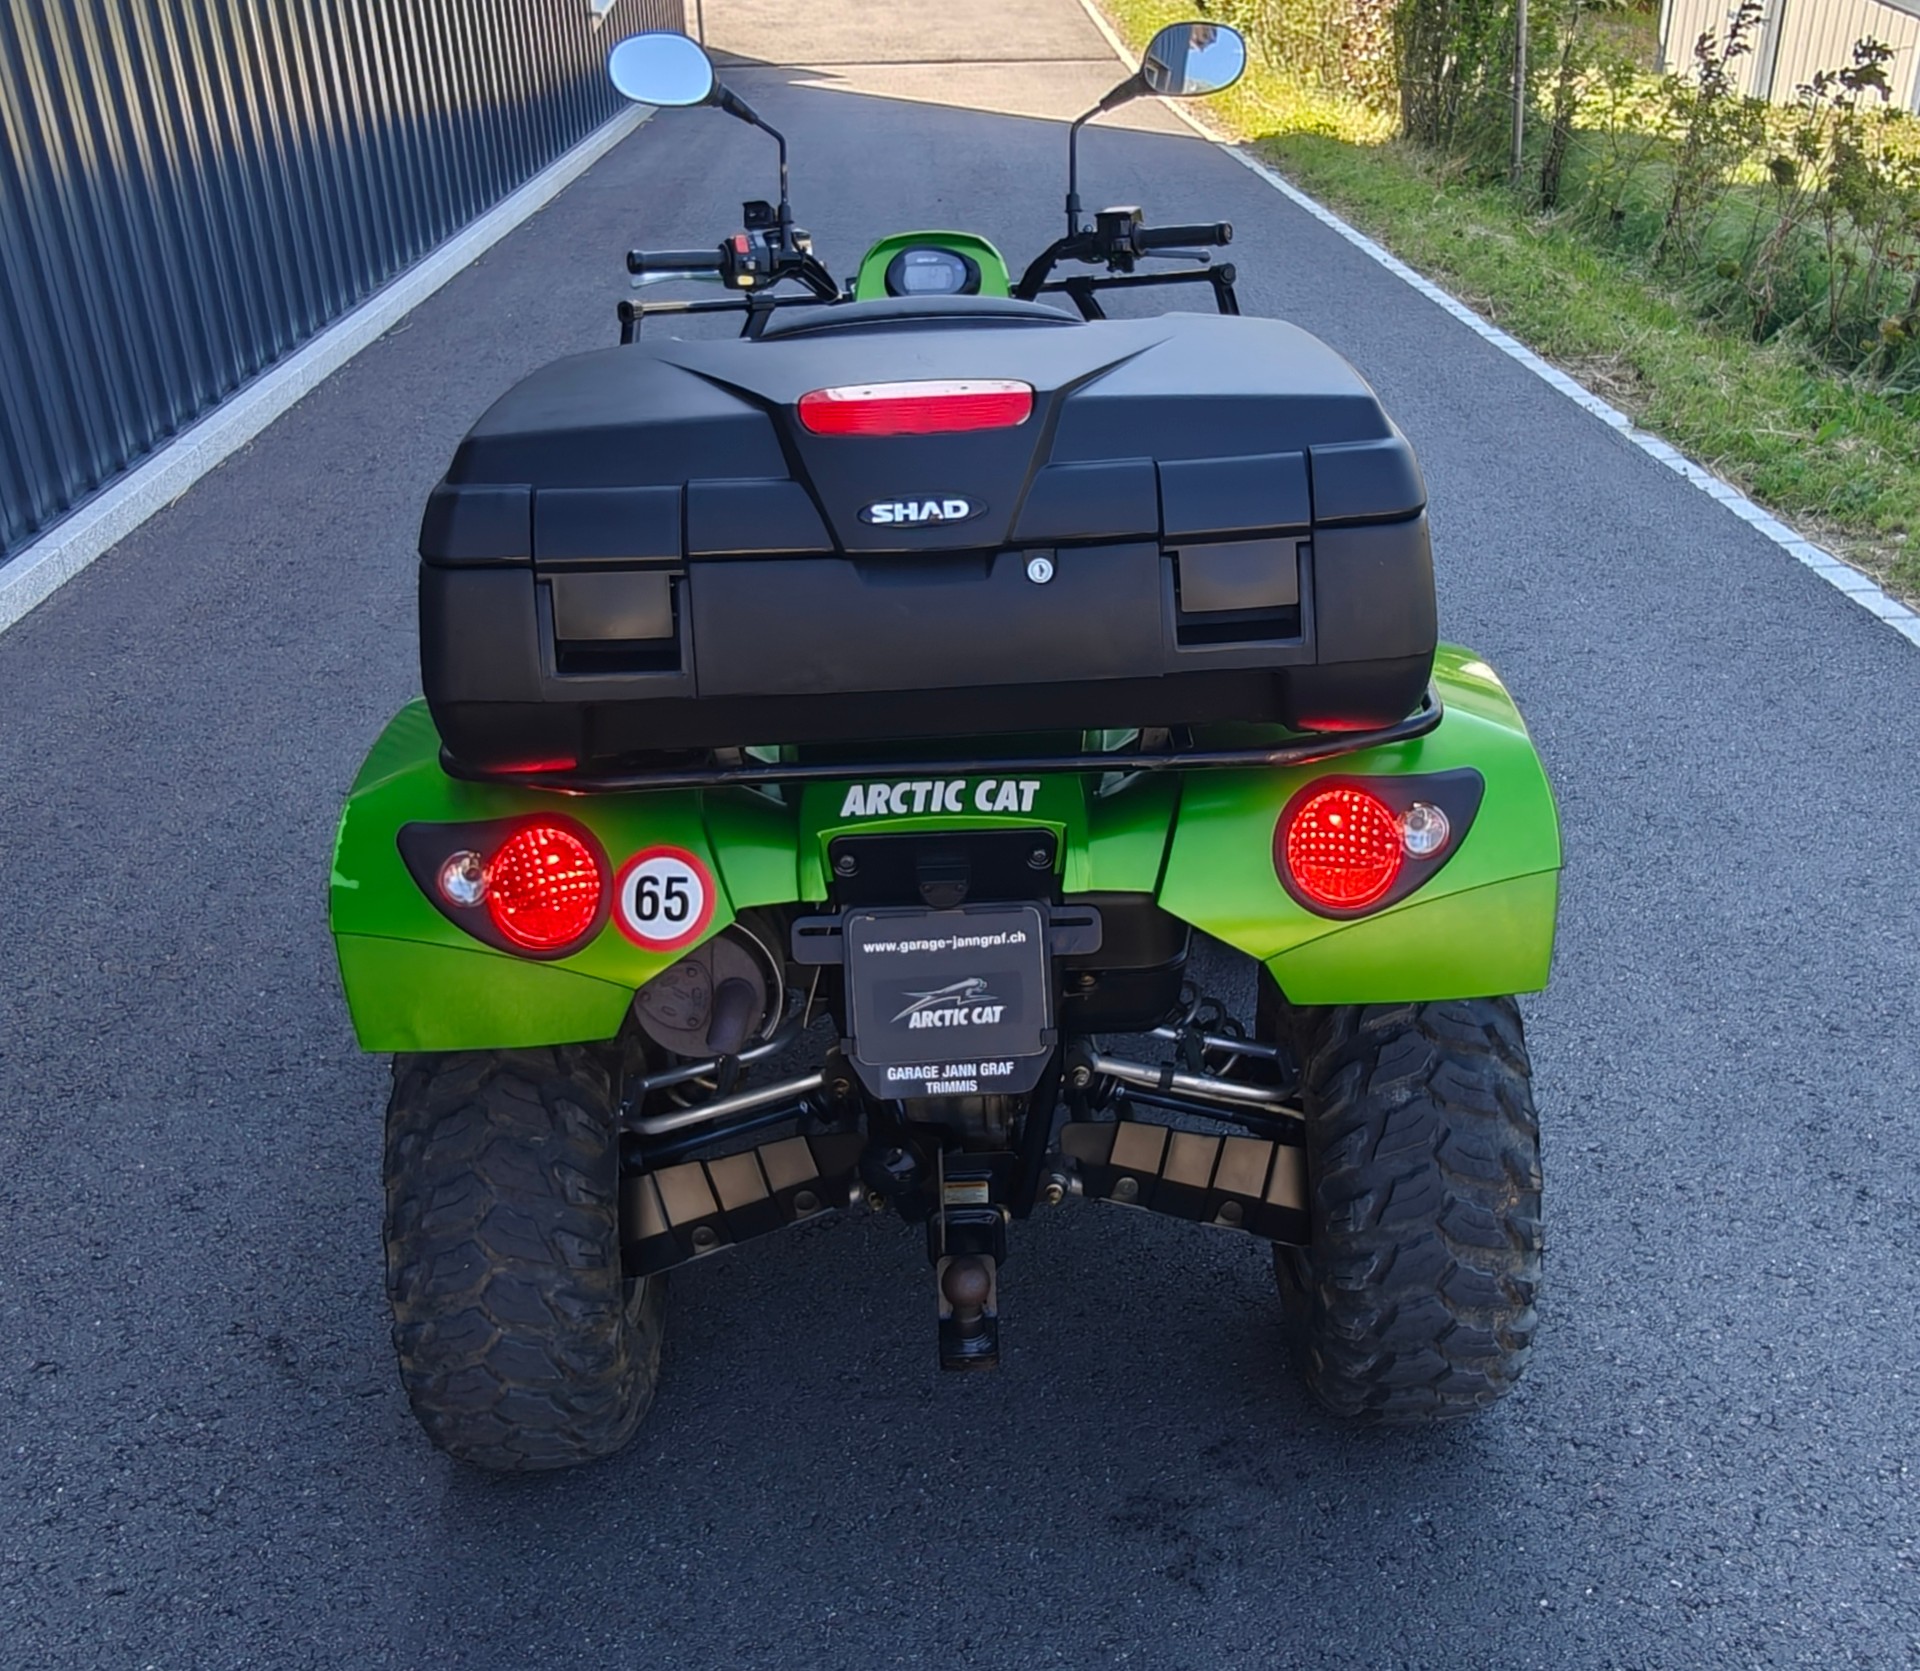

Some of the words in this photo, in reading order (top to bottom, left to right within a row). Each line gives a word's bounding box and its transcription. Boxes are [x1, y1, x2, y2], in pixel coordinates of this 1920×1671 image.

[870, 500, 969, 523] SHAD
[840, 780, 966, 817] ARCTIC
[974, 780, 1040, 812] CAT
[634, 875, 690, 921] 65
[863, 932, 1026, 953] www.garage-janngraf.ch
[908, 1007, 968, 1028] ARCTIC
[971, 1006, 1005, 1025] CAT
[887, 1065, 939, 1081] GARAGE
[941, 1064, 977, 1078] JANN
[980, 1062, 1015, 1076] GRAF
[925, 1080, 978, 1094] TRIMMIS
